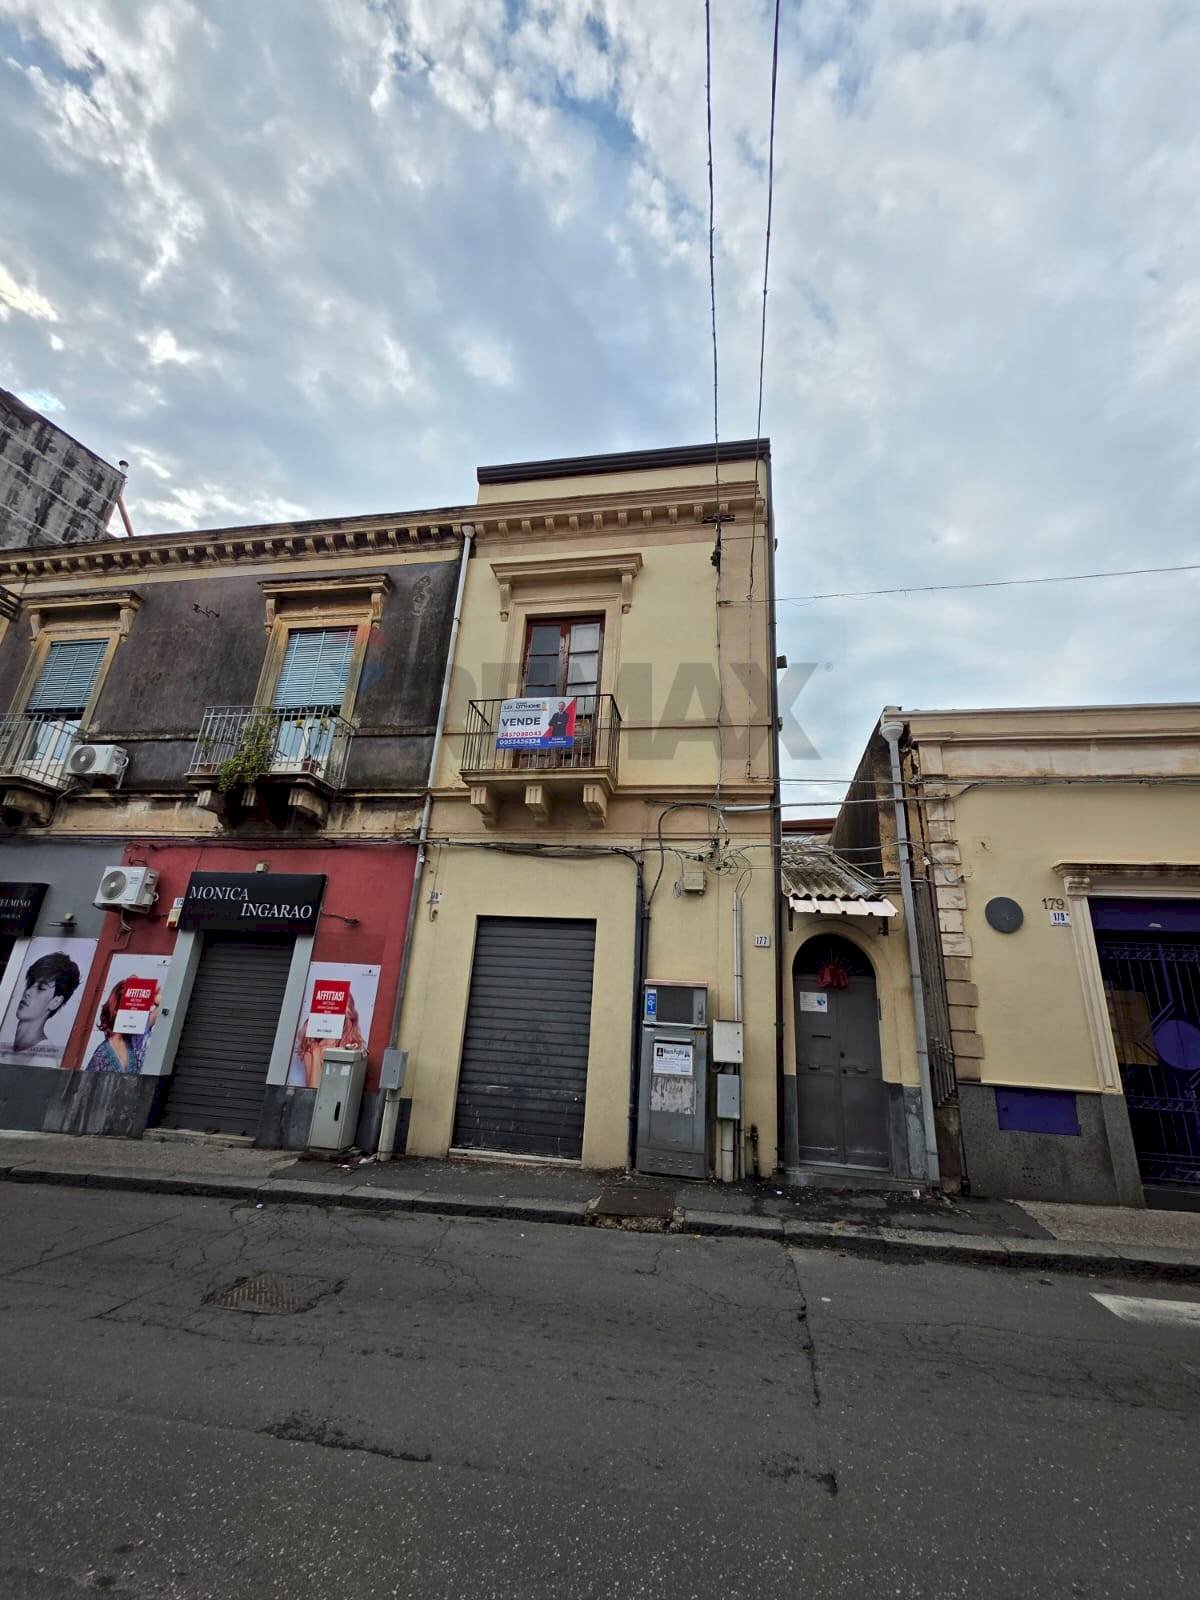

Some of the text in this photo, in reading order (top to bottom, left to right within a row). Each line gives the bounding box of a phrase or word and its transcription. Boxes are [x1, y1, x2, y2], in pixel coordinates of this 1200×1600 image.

[502, 717, 541, 726] VENDE
[189, 886, 249, 900] MONICA
[1041, 898, 1065, 910] 179
[240, 903, 312, 918] INGARAO
[756, 936, 768, 945] 177
[126, 989, 151, 998] AFFITTASI
[316, 991, 344, 1001] AFFITTASI
